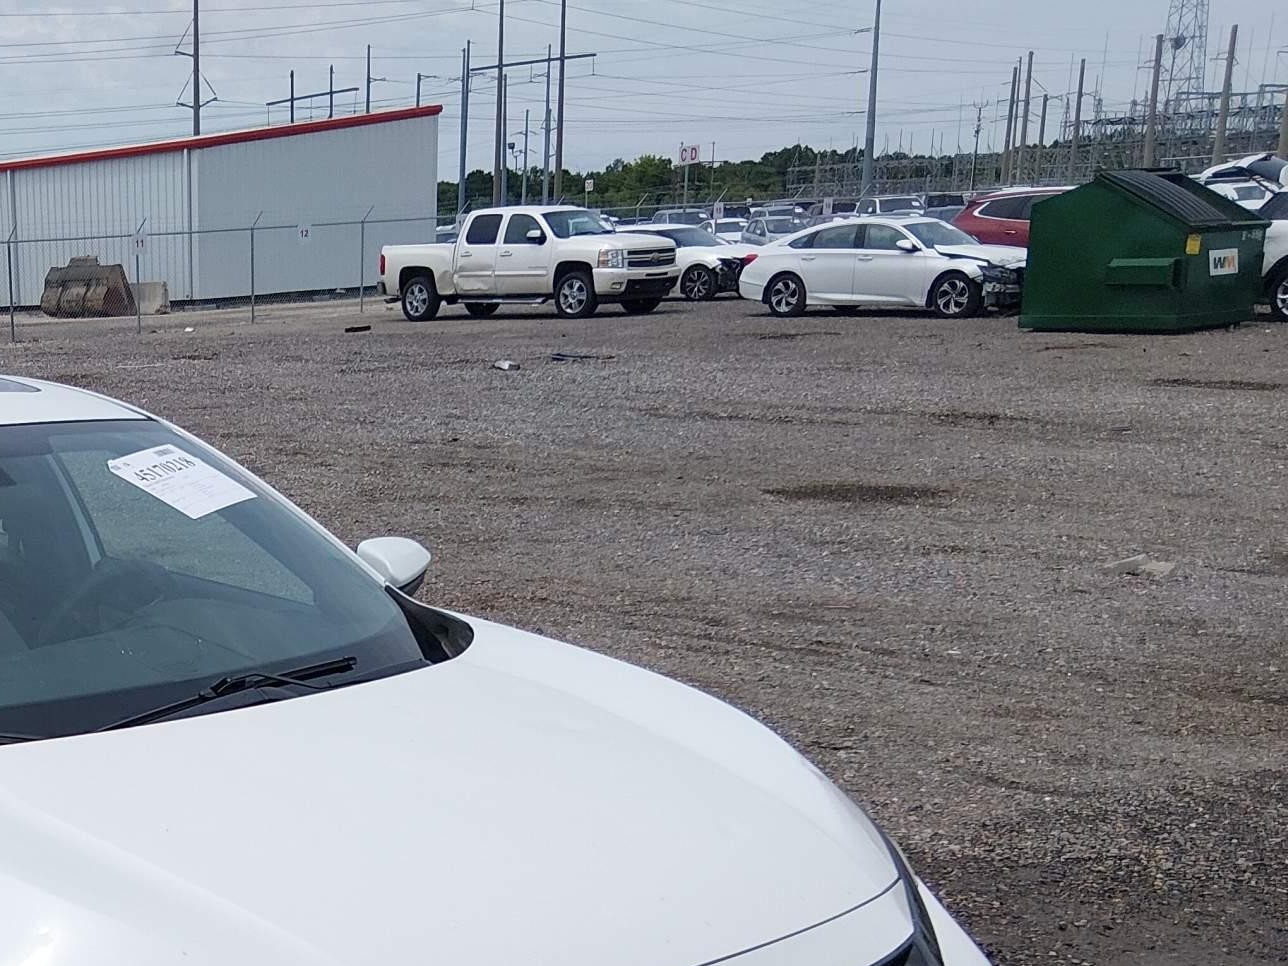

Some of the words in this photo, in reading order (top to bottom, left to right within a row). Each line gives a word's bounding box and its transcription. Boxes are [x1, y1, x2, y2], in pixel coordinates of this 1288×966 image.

[300, 229, 309, 238] 12
[135, 239, 144, 248] 11
[1213, 256, 1235, 270] WM
[133, 456, 197, 482] 45170218
